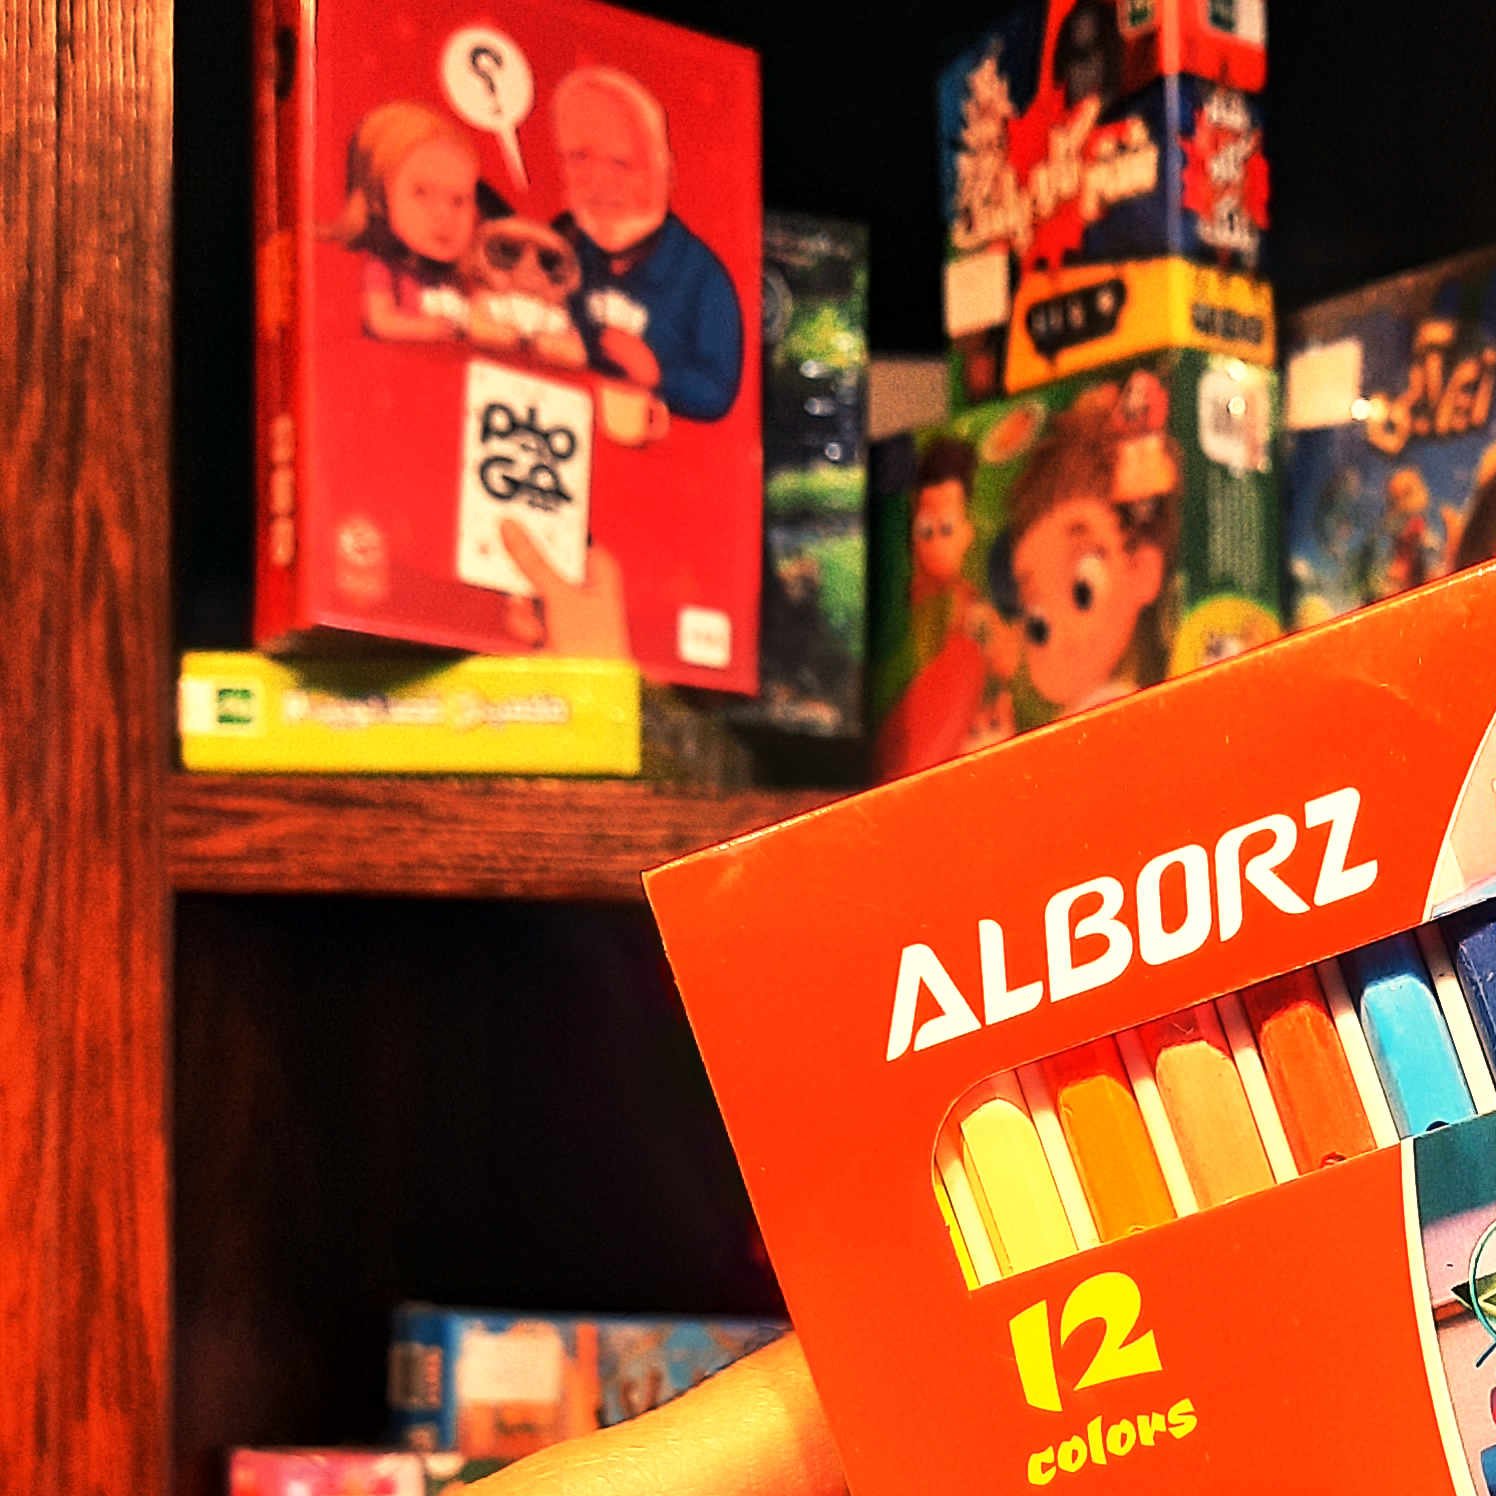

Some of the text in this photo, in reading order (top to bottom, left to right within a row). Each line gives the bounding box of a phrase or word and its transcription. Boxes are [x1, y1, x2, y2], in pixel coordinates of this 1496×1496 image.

[886, 787, 1379, 1062] ALBORZ
[1009, 1272, 1162, 1411] 12
[1027, 1398, 1197, 1485] colors
